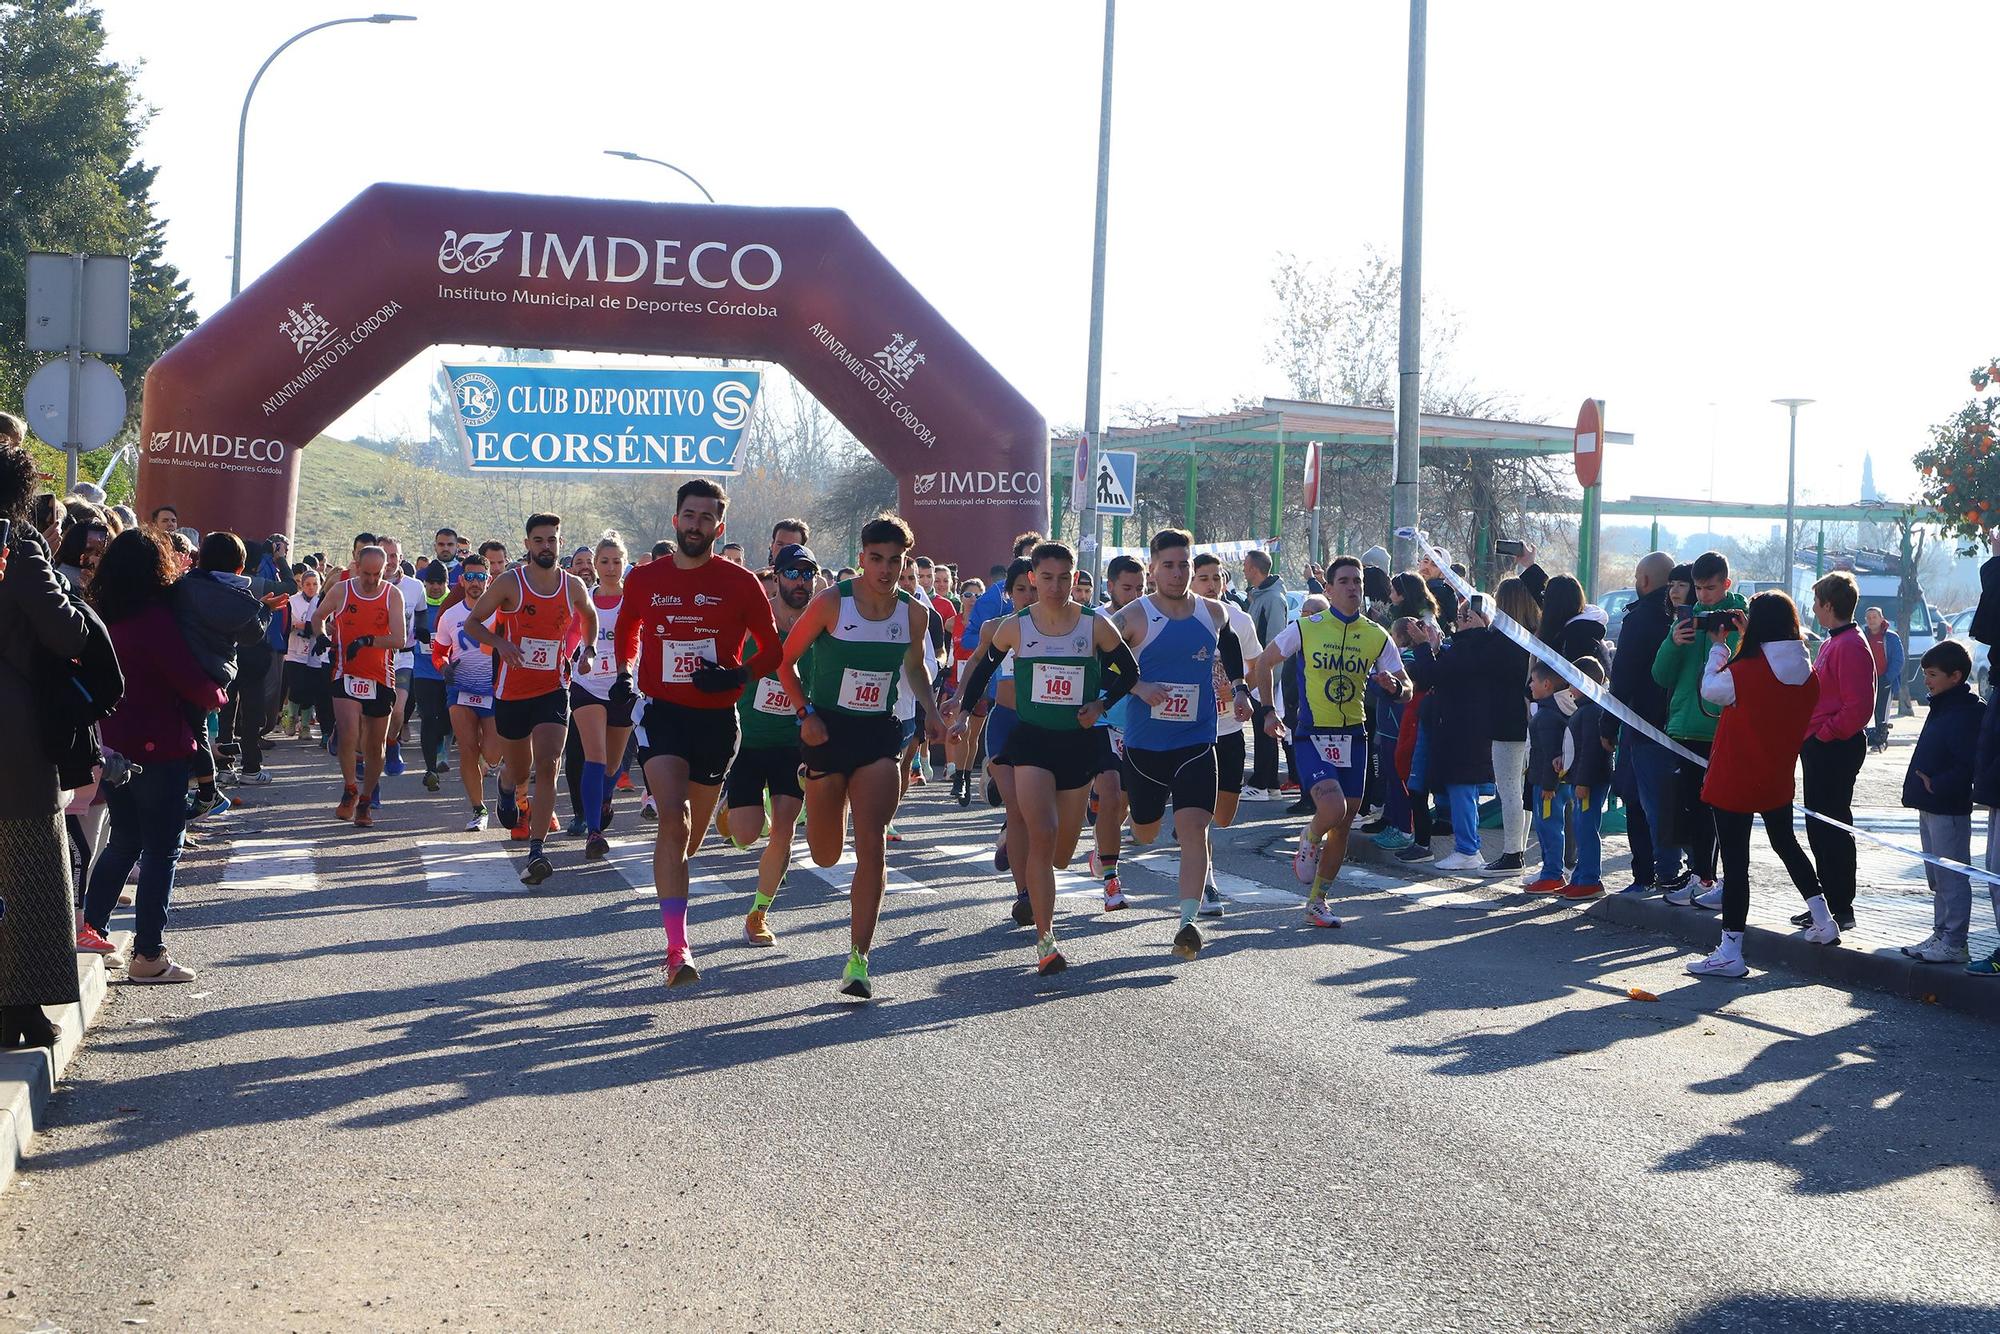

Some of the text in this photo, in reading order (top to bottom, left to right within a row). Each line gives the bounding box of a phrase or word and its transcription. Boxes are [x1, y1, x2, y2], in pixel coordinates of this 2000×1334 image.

[520, 231, 783, 291] IMDECO
[438, 285, 778, 317] Instituto Municipal de Deportes Córdoba
[261, 300, 402, 416] AYUNTAMIENTO DE CÓRDOBA
[808, 322, 937, 448] AYUNTAMIENTO DE CÓRDOBA
[507, 385, 704, 417] CLUB DEPORTIVO
[174, 431, 285, 463] IMDECO
[171, 458, 207, 468] Municipal
[220, 462, 255, 472] Deportes
[941, 472, 1041, 494] IMDECO
[938, 498, 974, 506] Municipal
[986, 498, 1018, 506] Deportes
[532, 651, 547, 664] 23
[601, 660, 609, 671] 4
[674, 656, 704, 673] 259
[352, 683, 369, 694] 106
[855, 686, 880, 702] 148
[1045, 679, 1072, 696] 149
[766, 692, 791, 708] 290
[1164, 698, 1188, 713] 212
[1324, 747, 1340, 760] 38
